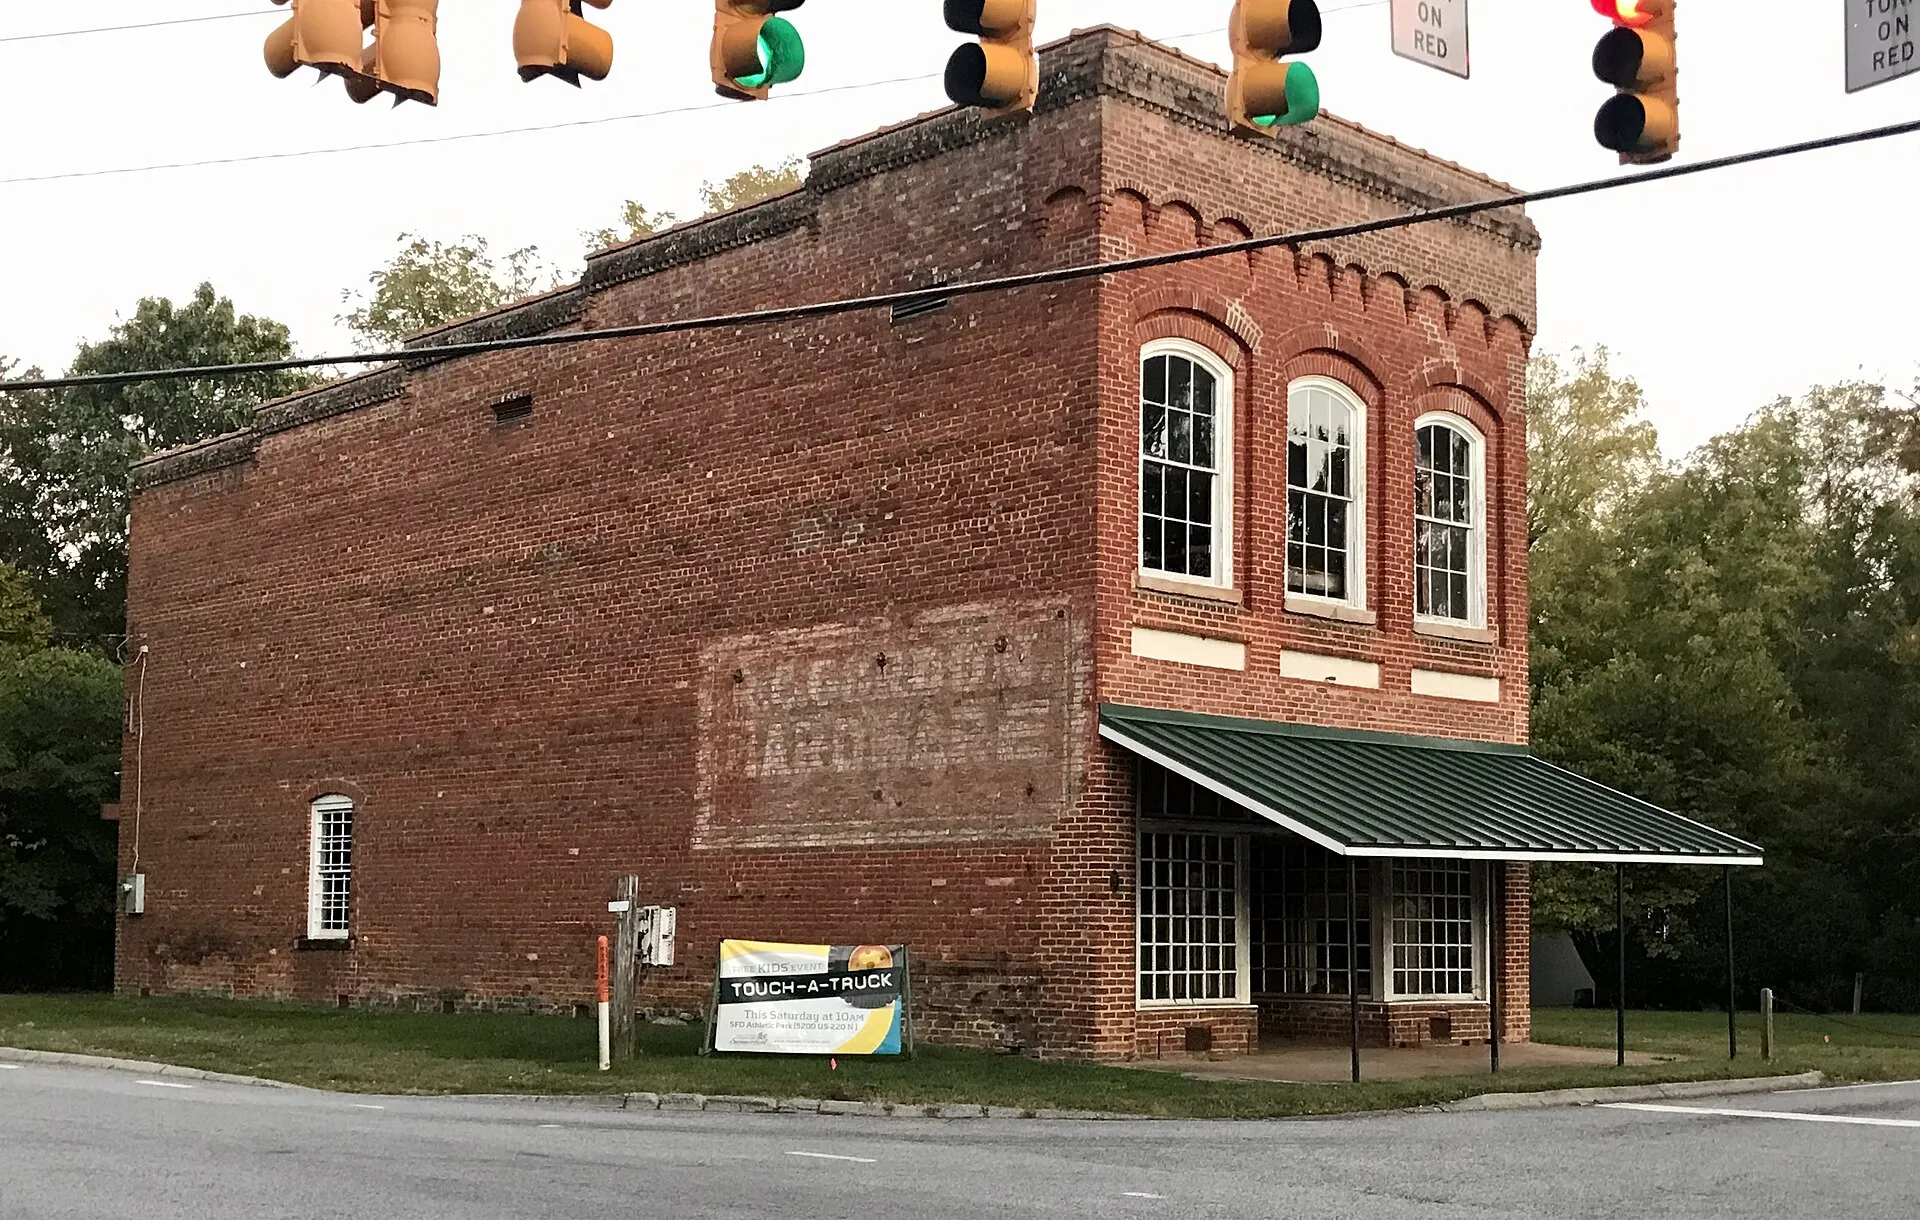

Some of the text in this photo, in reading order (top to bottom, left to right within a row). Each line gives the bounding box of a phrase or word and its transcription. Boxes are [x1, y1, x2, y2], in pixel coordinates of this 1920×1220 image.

[1418, 2, 1442, 28] ON
[1878, 14, 1909, 41] ON
[1414, 29, 1447, 58] RED
[1873, 41, 1914, 71] RED
[731, 973, 892, 997] TOUCH-A-TRUCK
[744, 1009, 767, 1019] This
[770, 1010, 820, 1022] Saturday
[822, 1012, 833, 1021] at
[746, 1021, 774, 1029] Athletic
